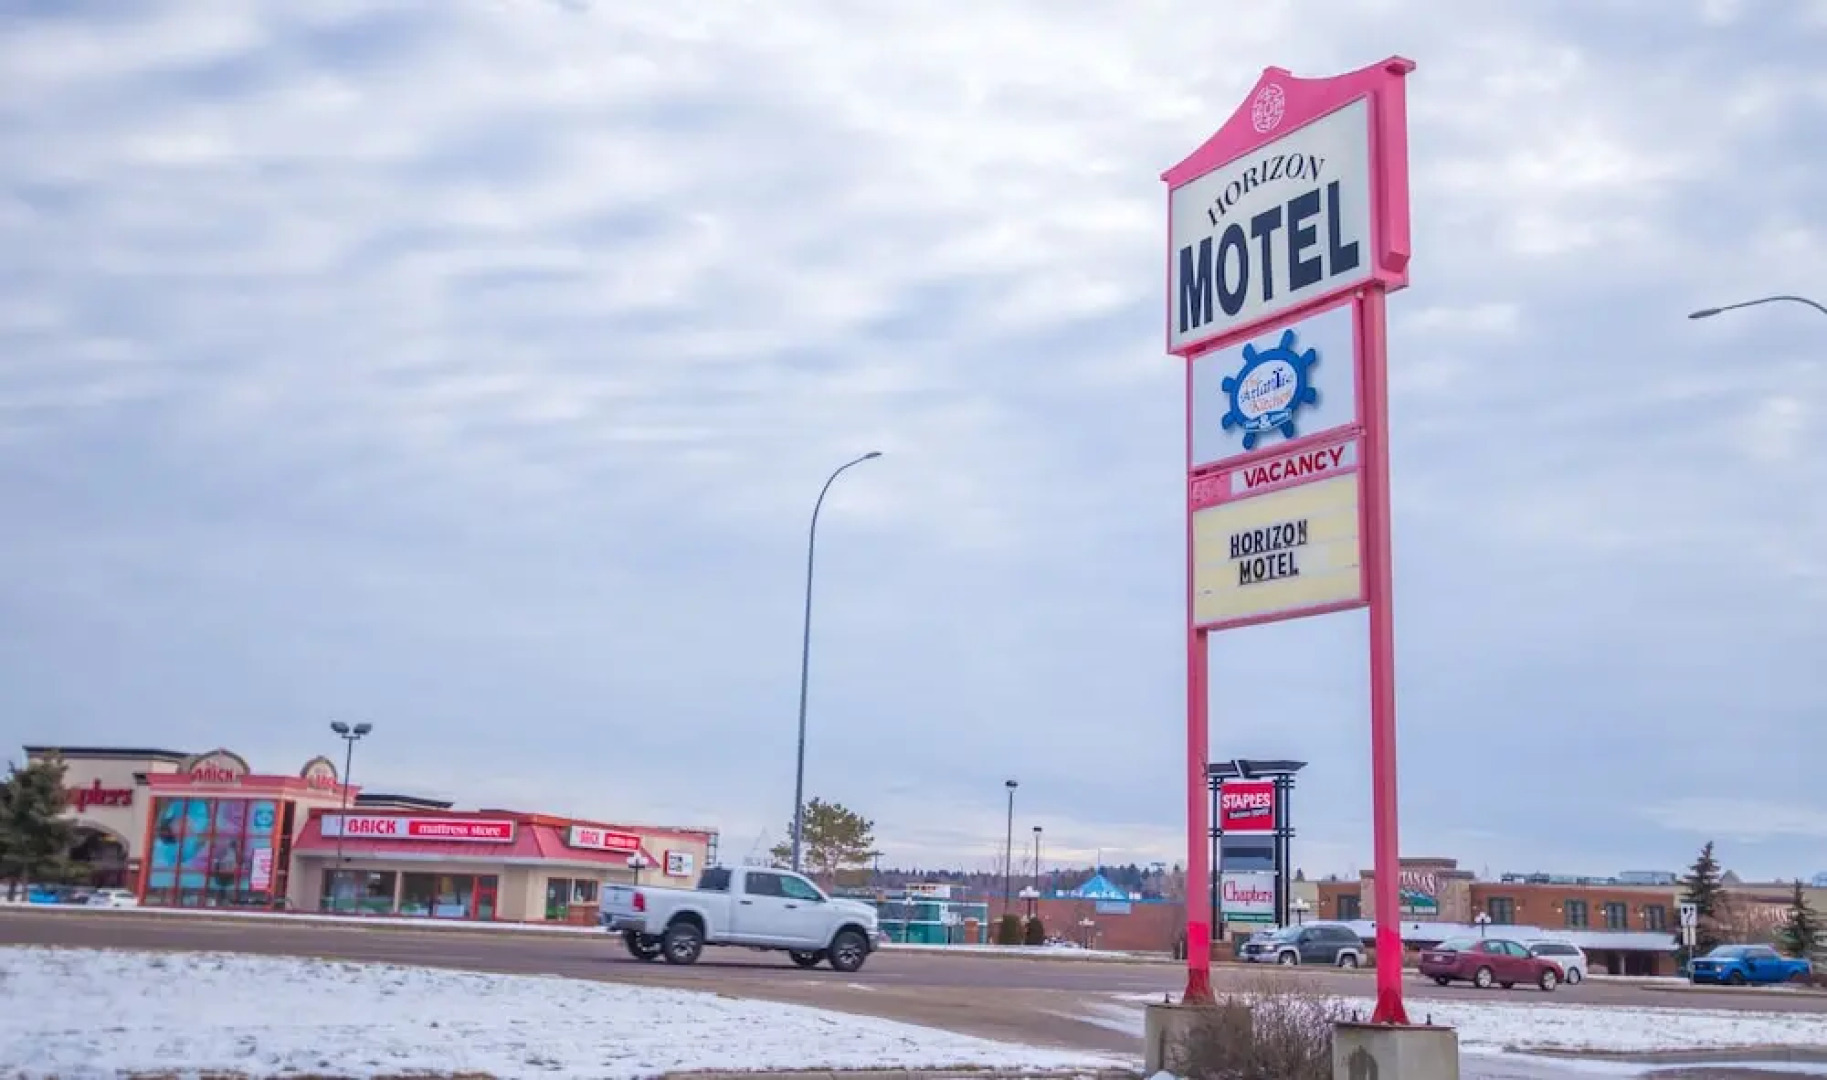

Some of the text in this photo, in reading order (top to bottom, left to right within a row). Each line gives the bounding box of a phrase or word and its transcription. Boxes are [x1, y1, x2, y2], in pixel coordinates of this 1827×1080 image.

[1207, 153, 1325, 227] HORIZON
[1179, 180, 1359, 334] MOTEL
[1244, 446, 1344, 488] VACANCY
[1230, 519, 1307, 559] HORIZON
[1240, 551, 1299, 585] MOTEL
[1222, 792, 1270, 809] STAPLES
[349, 818, 396, 834] BRICK
[418, 823, 501, 837] mattress store
[1223, 880, 1272, 906] Chapters
